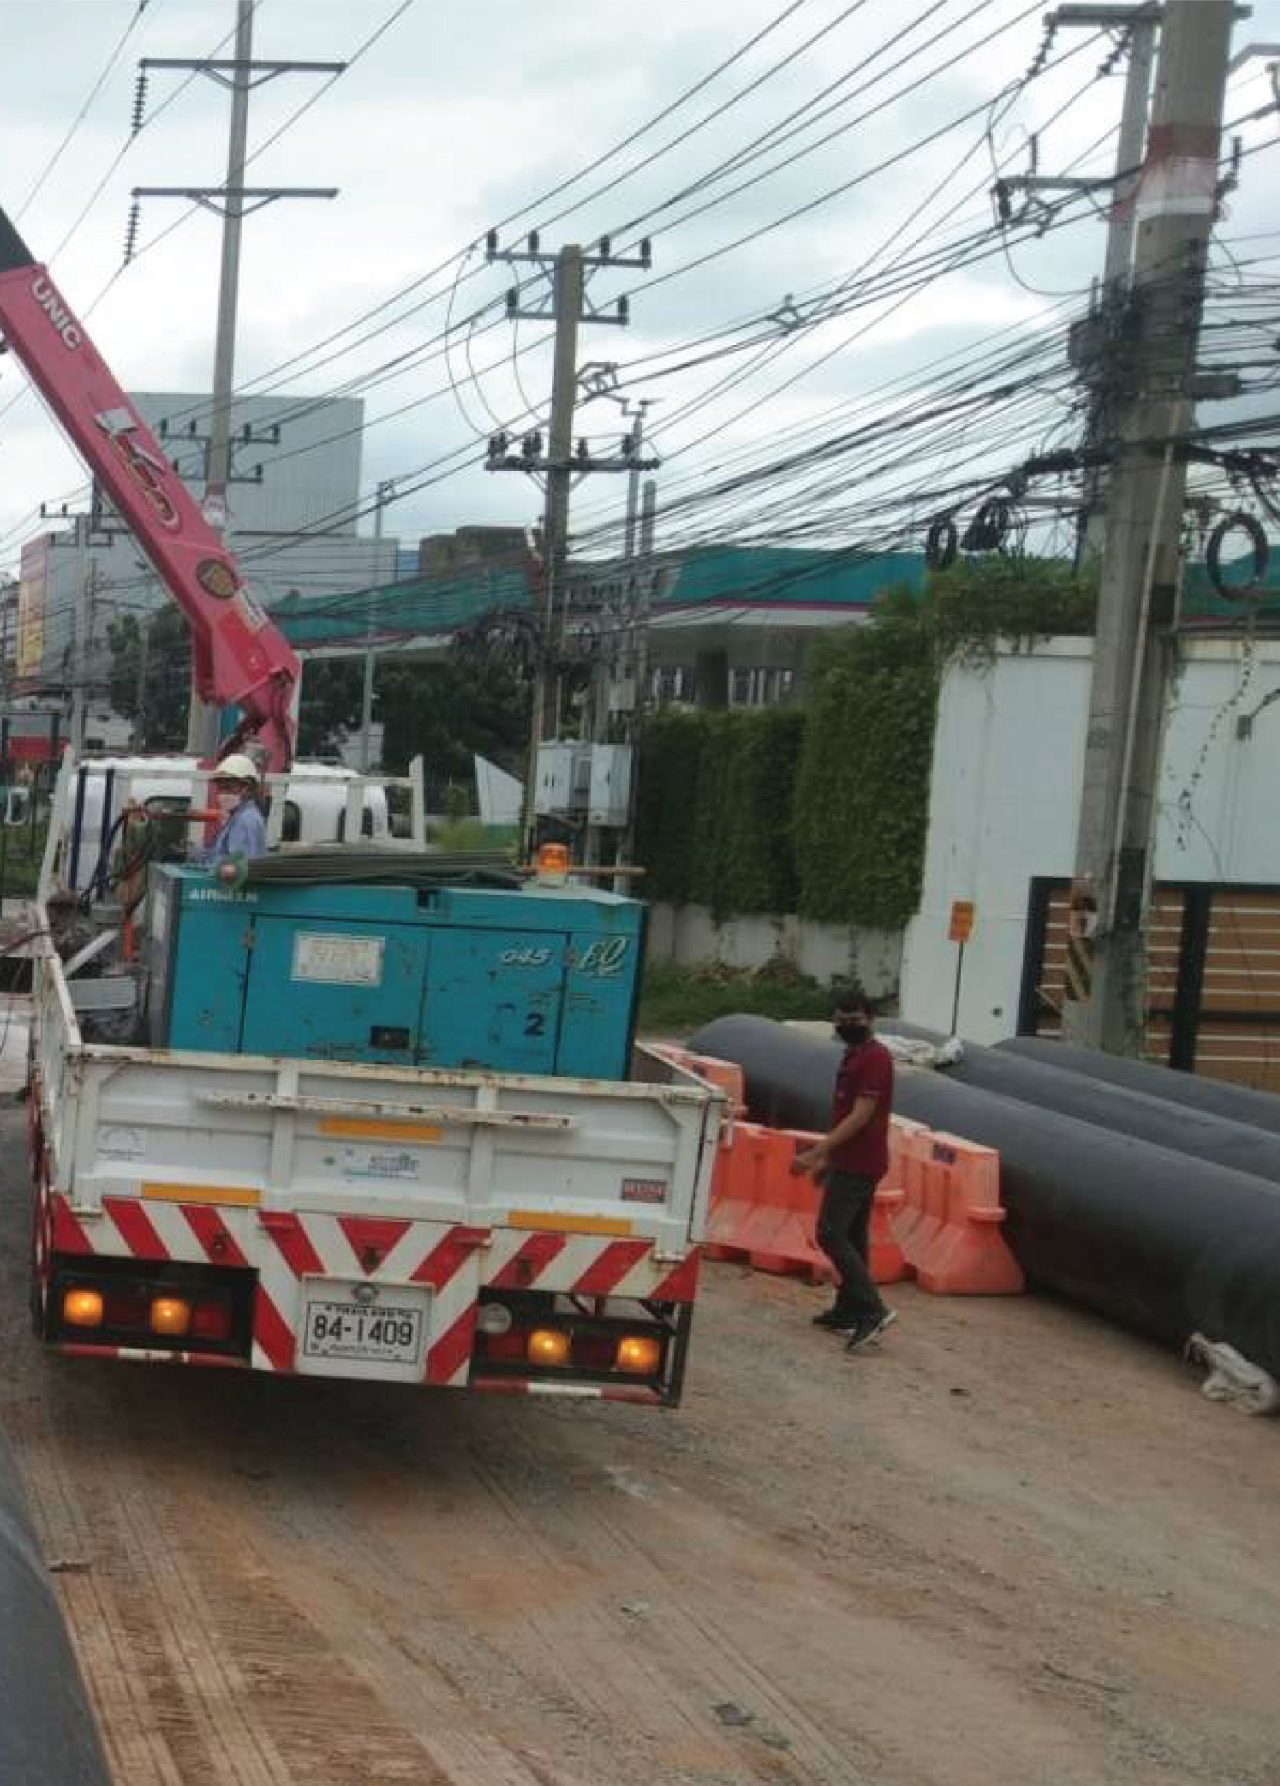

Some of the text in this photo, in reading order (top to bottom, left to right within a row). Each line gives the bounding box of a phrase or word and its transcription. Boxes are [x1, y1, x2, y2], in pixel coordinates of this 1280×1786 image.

[31, 275, 83, 350] UNIC
[522, 1012, 546, 1036] 2
[313, 1313, 413, 1346] 84-1409
